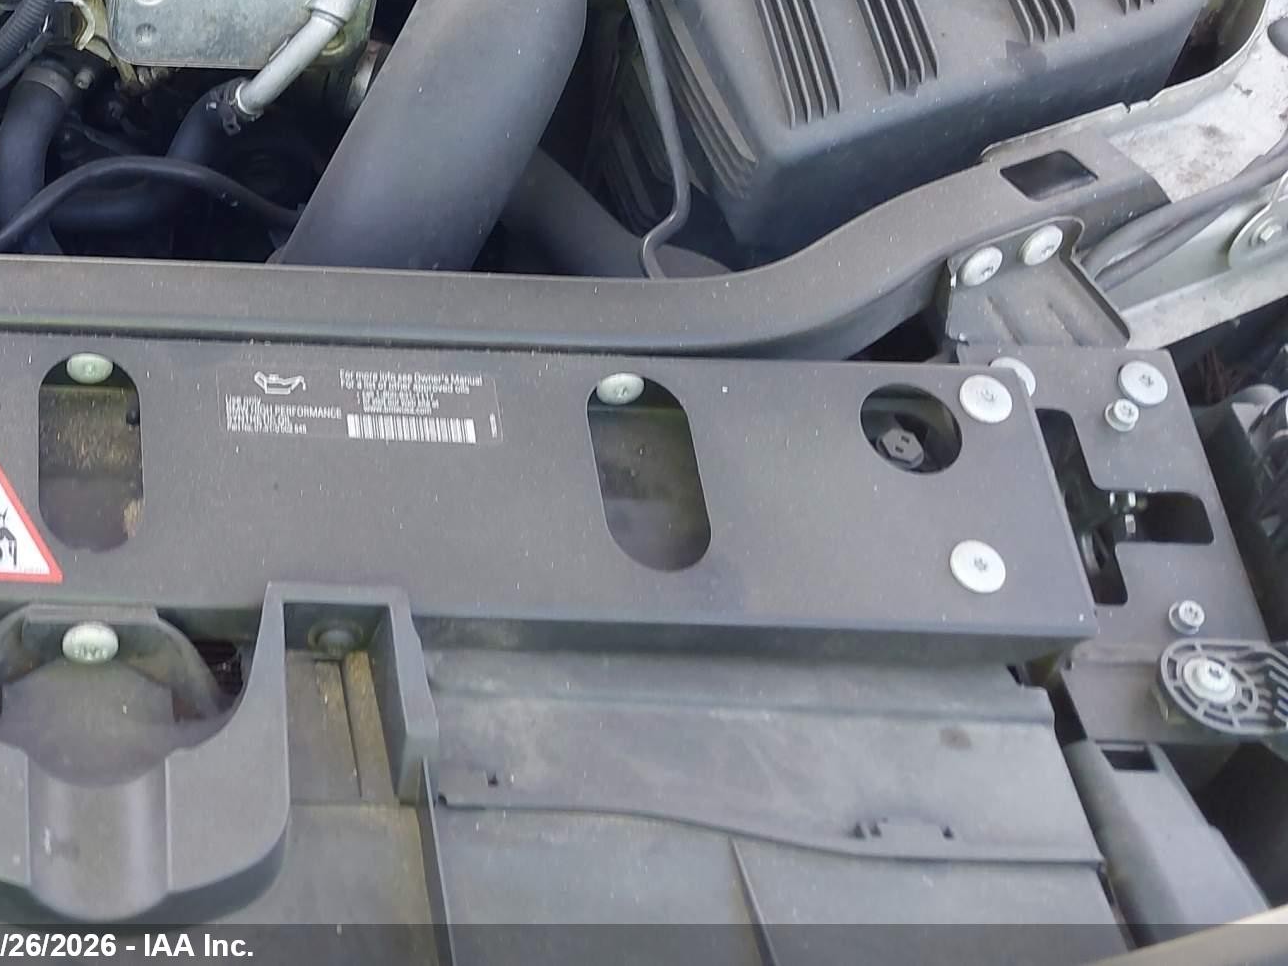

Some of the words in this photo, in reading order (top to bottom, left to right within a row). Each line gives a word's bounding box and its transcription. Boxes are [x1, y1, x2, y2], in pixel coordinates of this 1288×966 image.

[355, 370, 378, 381] more
[414, 371, 449, 384] Owner's
[450, 372, 483, 387] Manual
[274, 404, 342, 419] PERFORMANCE
